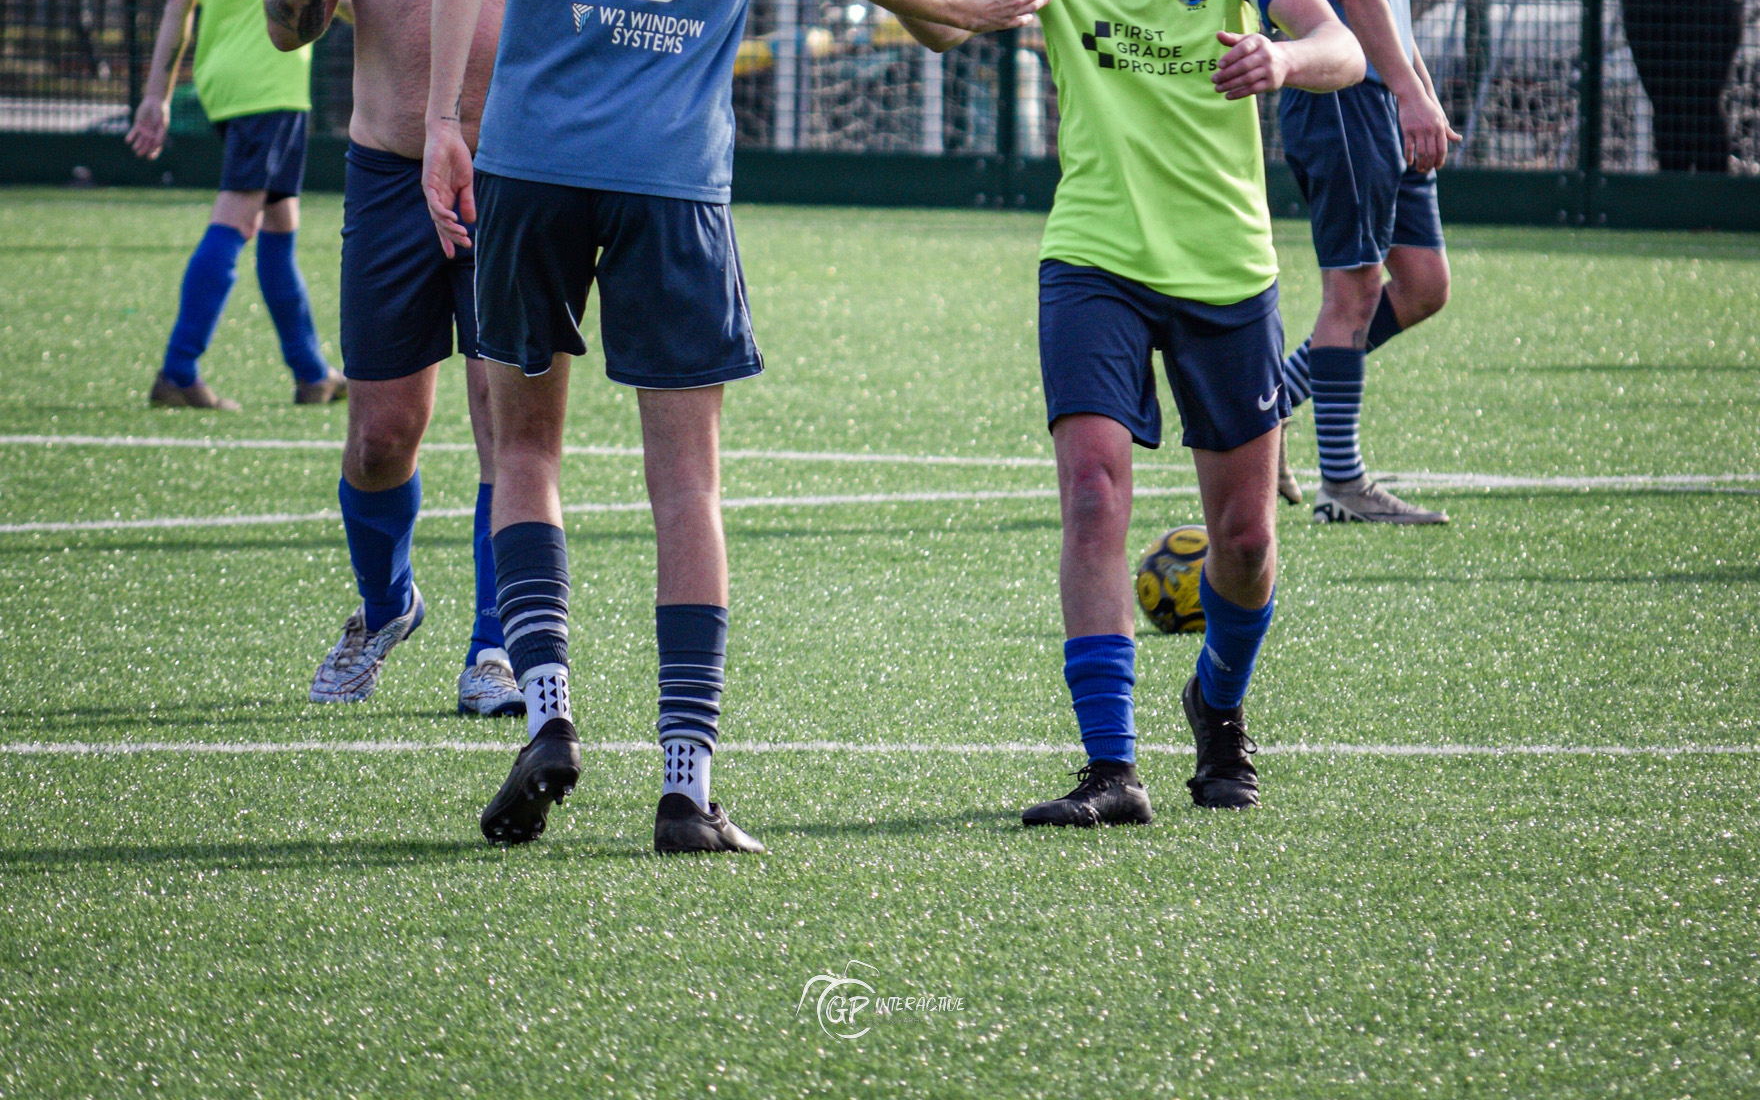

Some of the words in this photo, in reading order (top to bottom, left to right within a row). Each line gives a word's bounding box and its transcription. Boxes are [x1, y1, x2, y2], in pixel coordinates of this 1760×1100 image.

[599, 6, 625, 27] W2
[630, 11, 705, 38] WINDOW
[611, 27, 683, 54] SYSTEMS
[1114, 23, 1165, 42] FIRST
[1116, 42, 1182, 58] GRADE
[1117, 58, 1217, 75] PROJECTS
